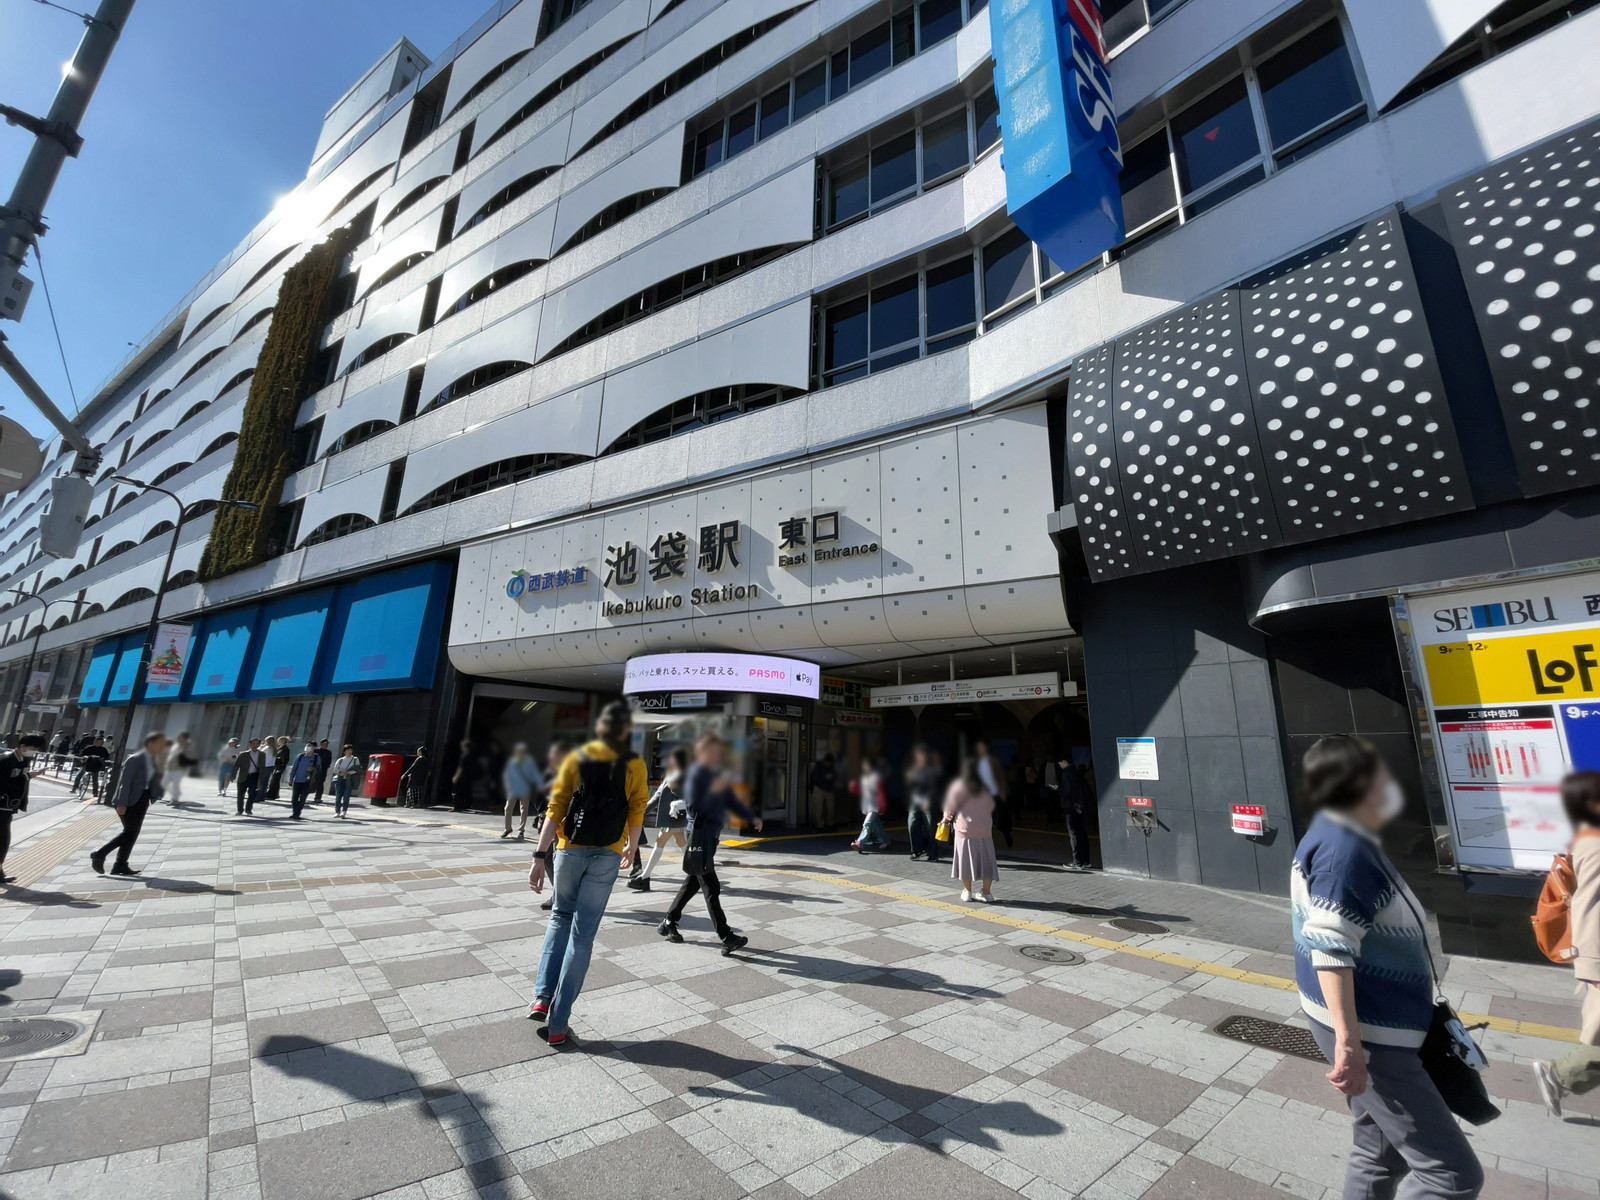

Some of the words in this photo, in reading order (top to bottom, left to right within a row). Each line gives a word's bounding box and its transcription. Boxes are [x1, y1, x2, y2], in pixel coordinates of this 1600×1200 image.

[778, 511, 840, 551] 東口
[603, 520, 741, 589] 池袋駅
[778, 551, 808, 568] East
[814, 541, 879, 563] Entrance
[528, 566, 587, 593] 西武鉄道
[601, 592, 682, 618] Ikebukuro
[690, 582, 759, 606] Station
[1434, 596, 1559, 633] SEIBU
[749, 668, 786, 680] PASMO
[802, 673, 813, 686] Pay
[1467, 709, 1519, 719] 工事中告知
[1235, 820, 1260, 830] 工事中
